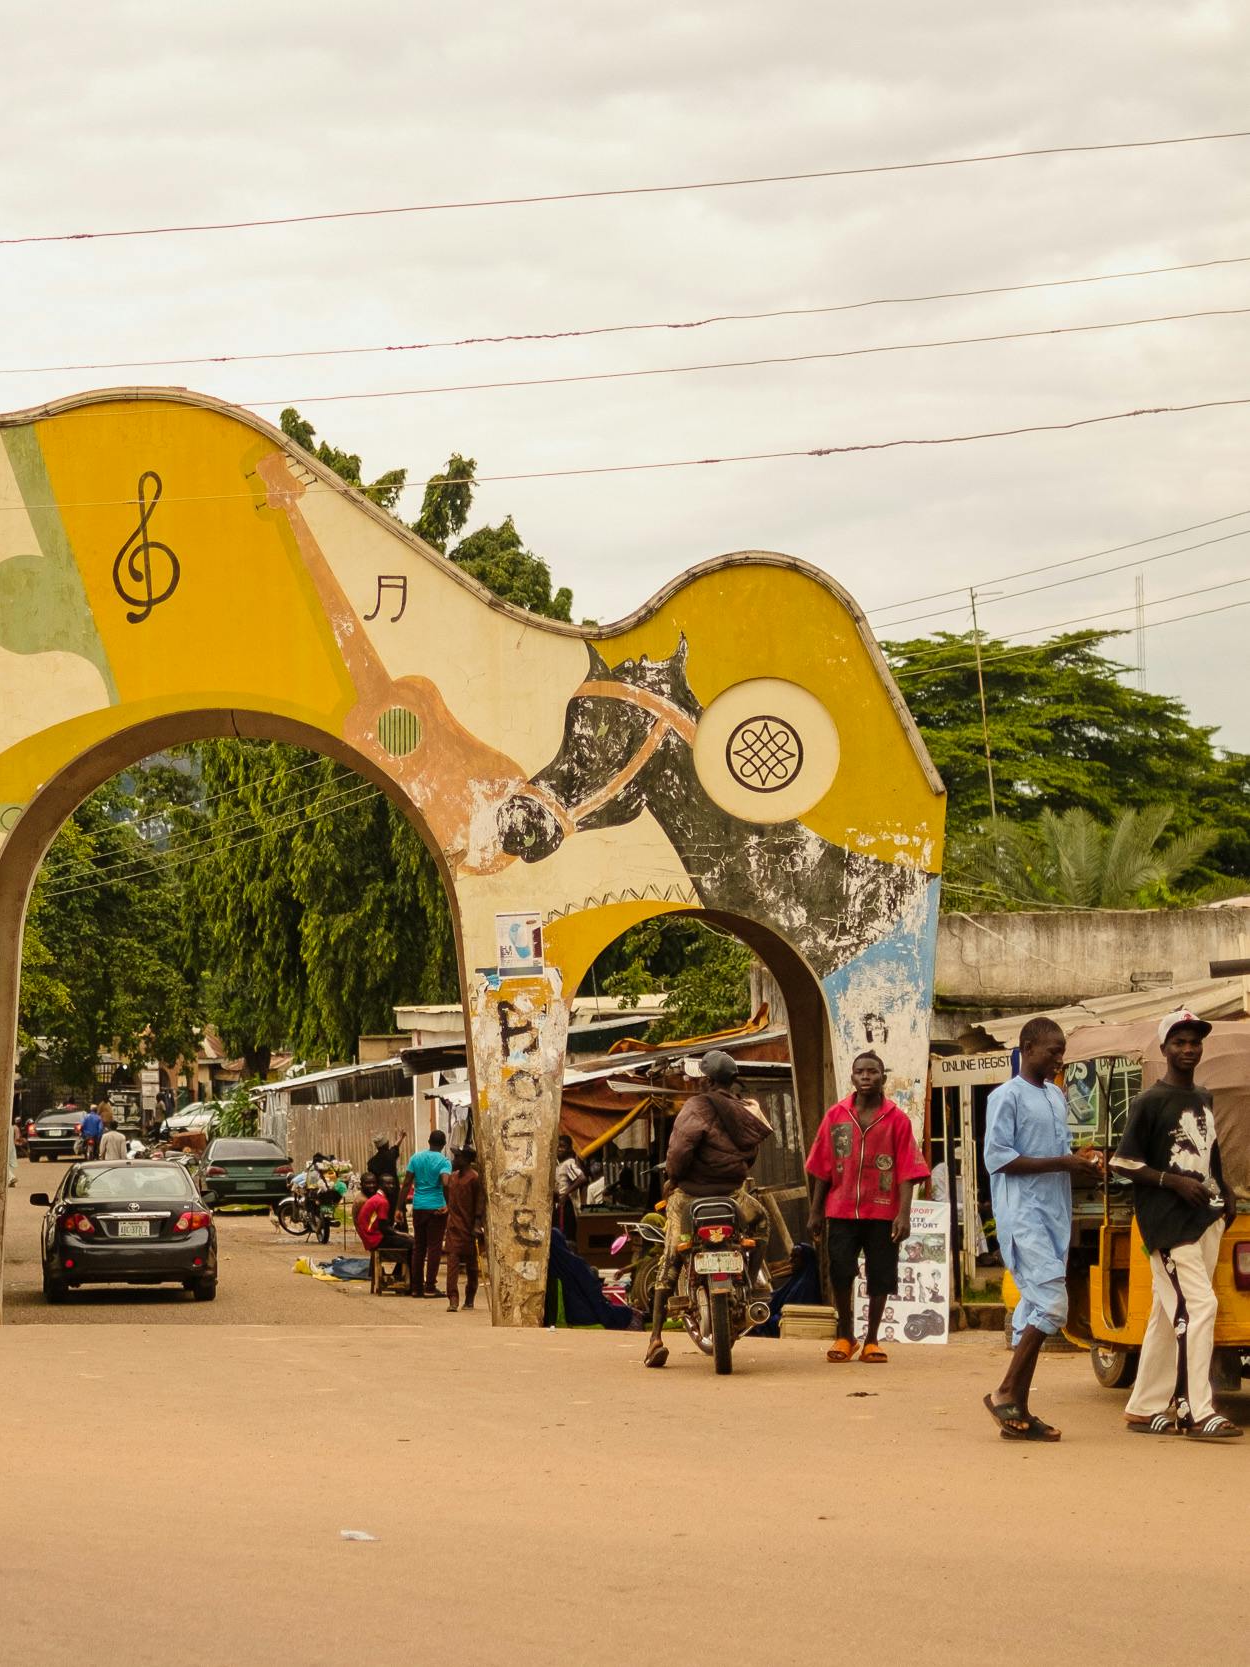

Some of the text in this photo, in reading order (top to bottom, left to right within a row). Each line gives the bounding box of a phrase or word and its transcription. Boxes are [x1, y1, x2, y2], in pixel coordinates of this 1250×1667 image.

[941, 1055, 1012, 1072] ONLINE REGIST
[910, 1207, 935, 1215] SPORT
